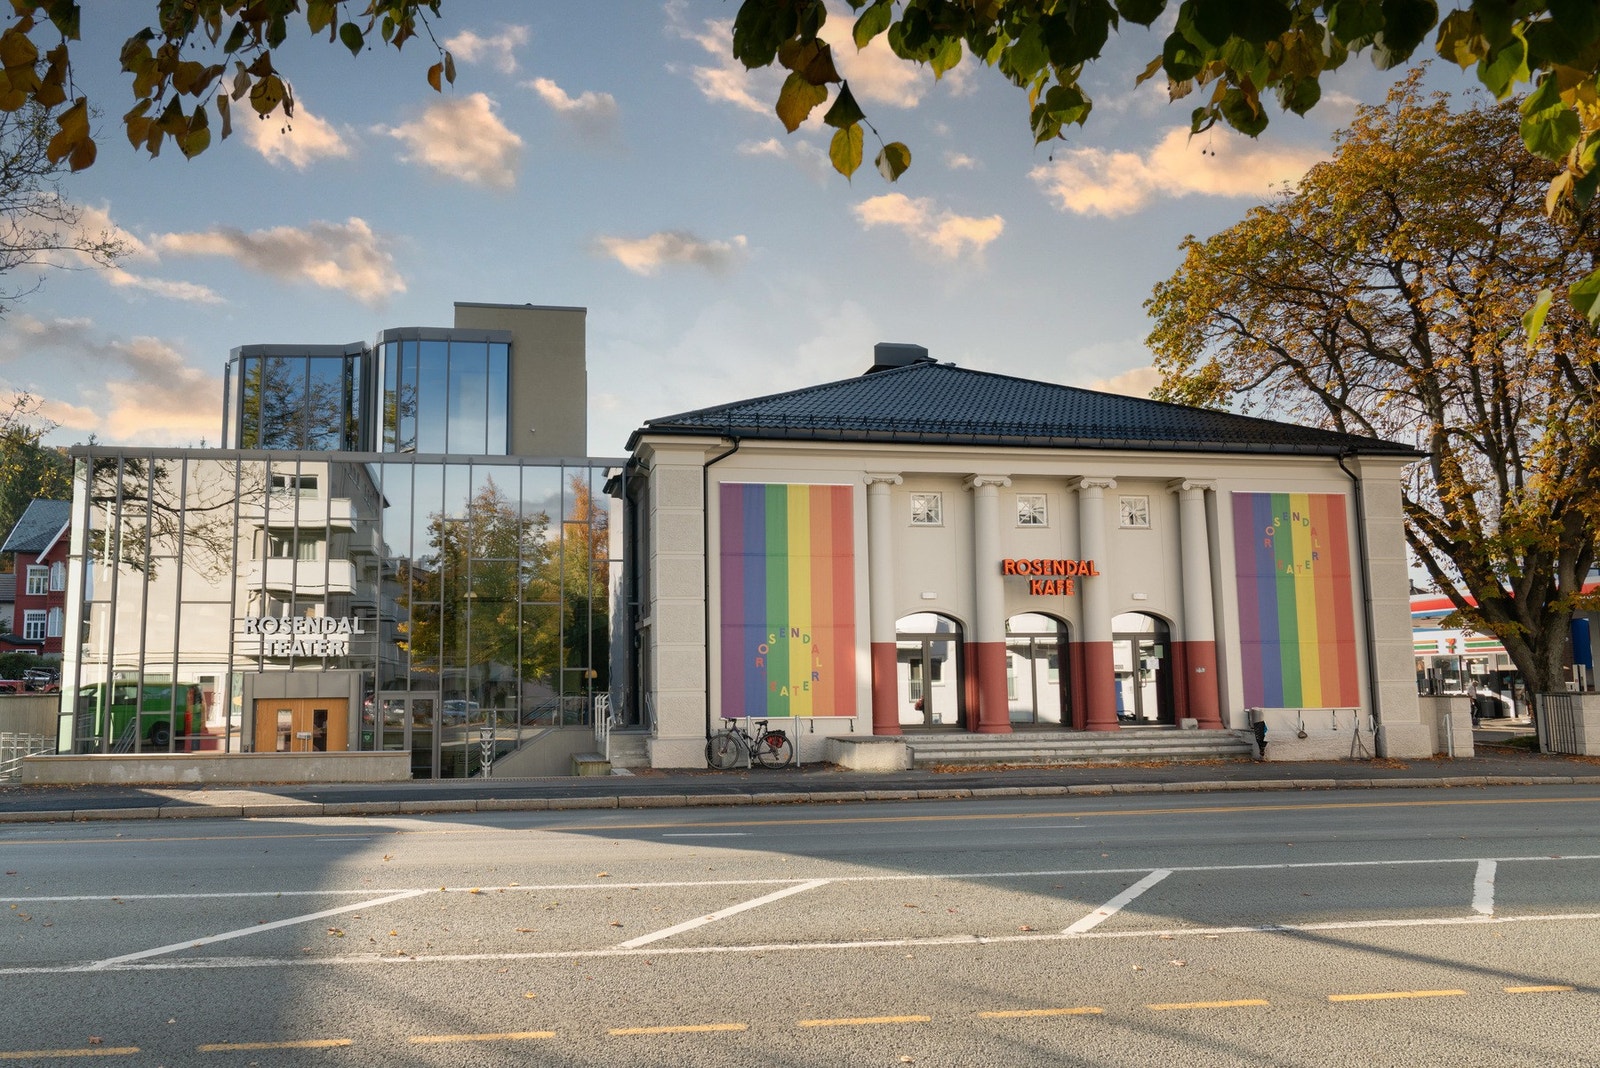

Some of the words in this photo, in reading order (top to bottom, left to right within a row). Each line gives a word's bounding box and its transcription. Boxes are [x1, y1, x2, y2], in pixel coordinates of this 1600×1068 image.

[1264, 511, 1321, 548] ROSENDAL
[1002, 558, 1100, 576] ROSENDAL
[1030, 577, 1075, 595] KAFÉ
[243, 616, 365, 634] ROSENDAL
[265, 638, 345, 657] TEATER
[755, 627, 823, 668] ROSENDAL
[760, 670, 820, 697] TEATER
